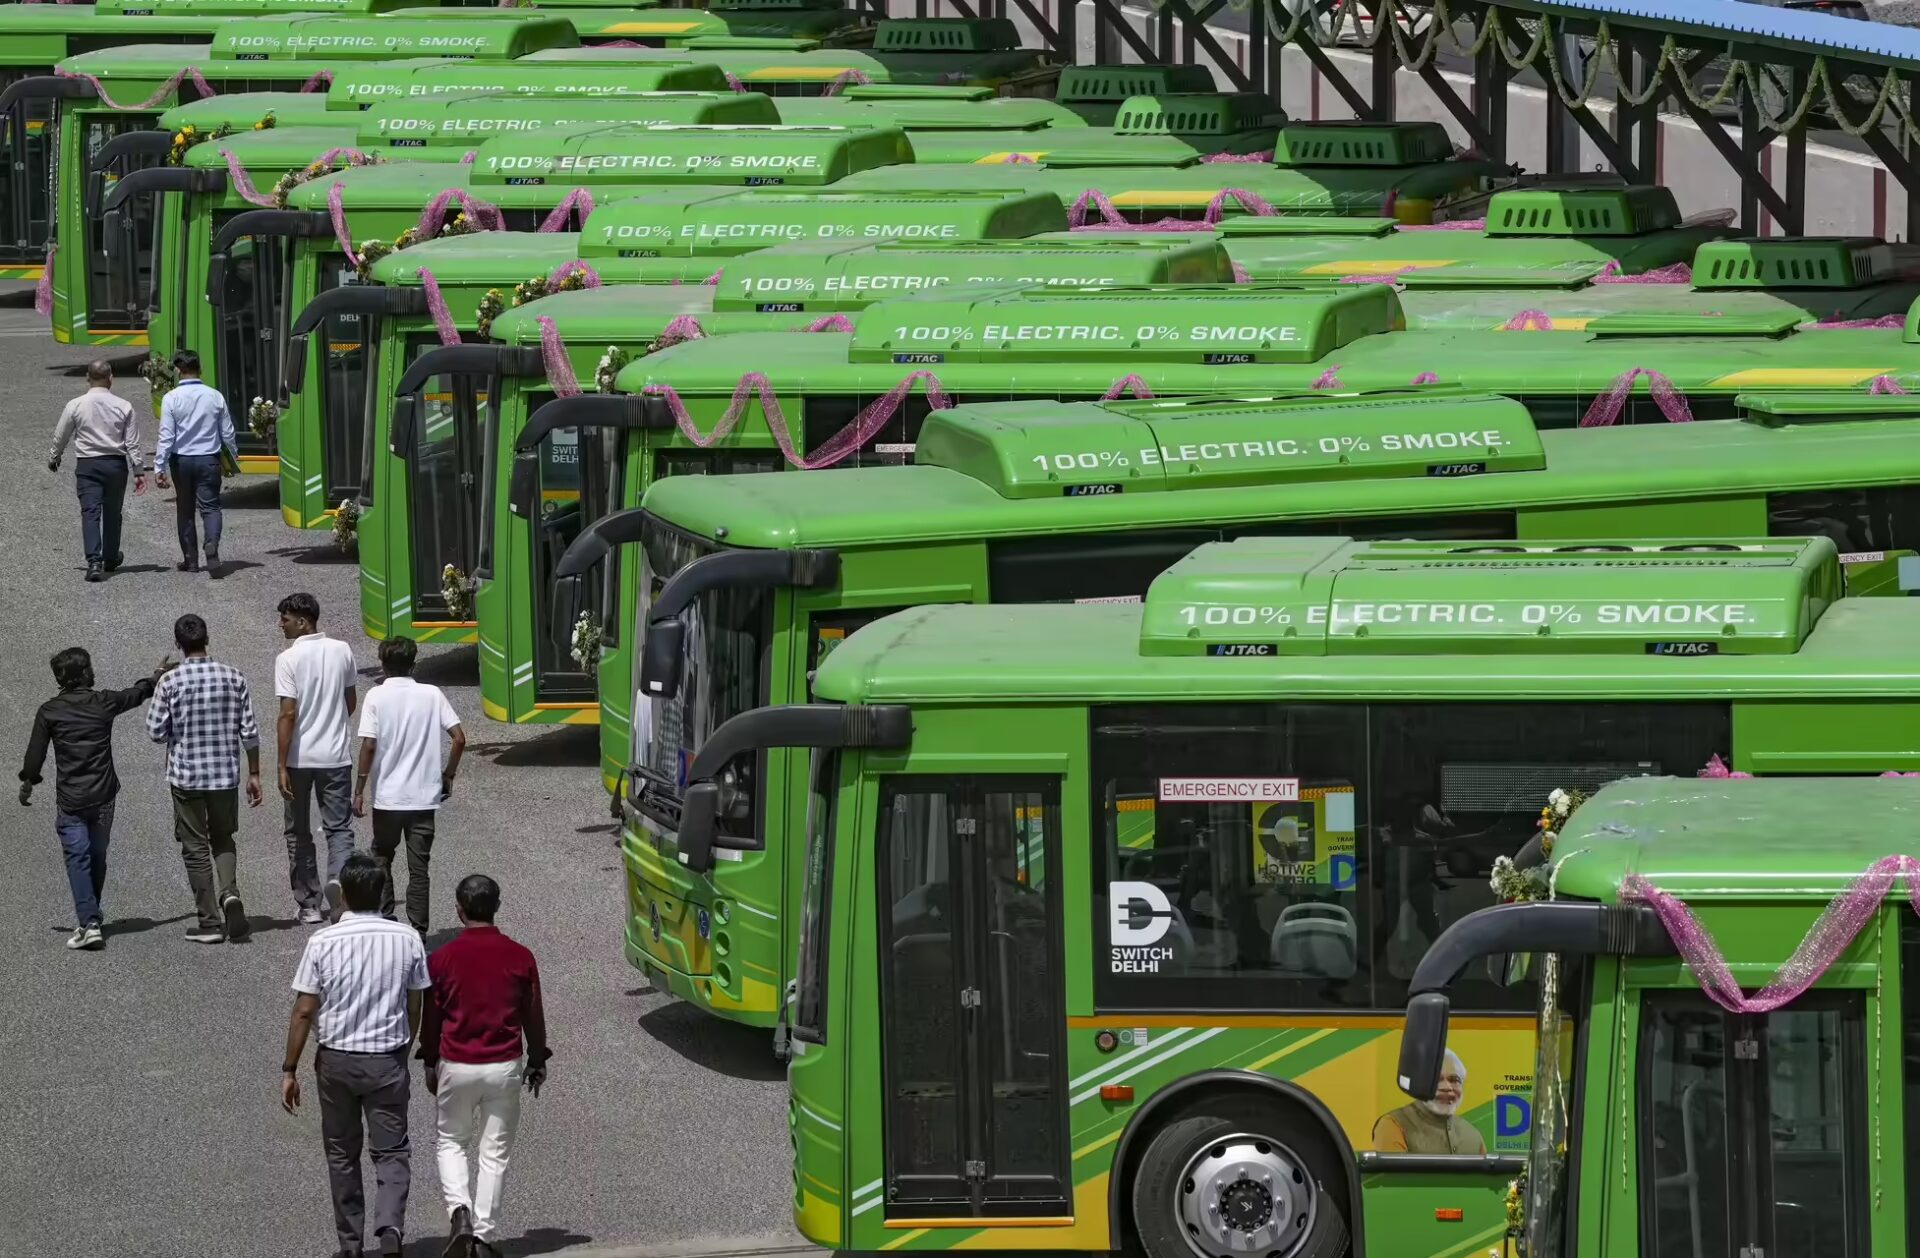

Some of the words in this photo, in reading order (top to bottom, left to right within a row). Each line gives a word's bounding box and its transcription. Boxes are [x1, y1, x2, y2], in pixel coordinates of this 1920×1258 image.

[228, 37, 280, 47] 100%
[286, 36, 377, 47] ELECTRIC.
[384, 37, 413, 46] 0%
[418, 37, 490, 46] SMOKE.
[346, 84, 403, 96] 100%
[377, 118, 435, 130] 100%
[487, 156, 552, 169] 100%
[560, 155, 676, 168] ELECTRIC.
[686, 155, 722, 168] 0%
[730, 155, 821, 168] SMOKE.
[602, 225, 672, 238] 100%
[681, 224, 807, 237] ELECTRIC.
[817, 225, 855, 237] 0%
[863, 225, 960, 237] SMOKE.
[740, 278, 815, 291] 100%
[895, 326, 974, 340] 100%
[983, 325, 1124, 340] ELECTRIC.
[1136, 325, 1180, 340] 0%
[1190, 325, 1302, 341] SMOKE.
[1033, 452, 1129, 471] 100%
[1140, 439, 1308, 465] ELECTRIC.
[1319, 436, 1370, 453] 0%
[1381, 430, 1511, 449] SMOKE.
[1180, 605, 1291, 626] 100%
[1306, 604, 1504, 624] ELECTRIC.
[1521, 605, 1582, 624] 0%
[1597, 604, 1756, 624] SMOKE.
[1163, 783, 1258, 796] EMERGENCY
[1262, 783, 1295, 796] EXIT
[1111, 947, 1173, 960] SWITCH
[1112, 960, 1159, 973] DELHI
